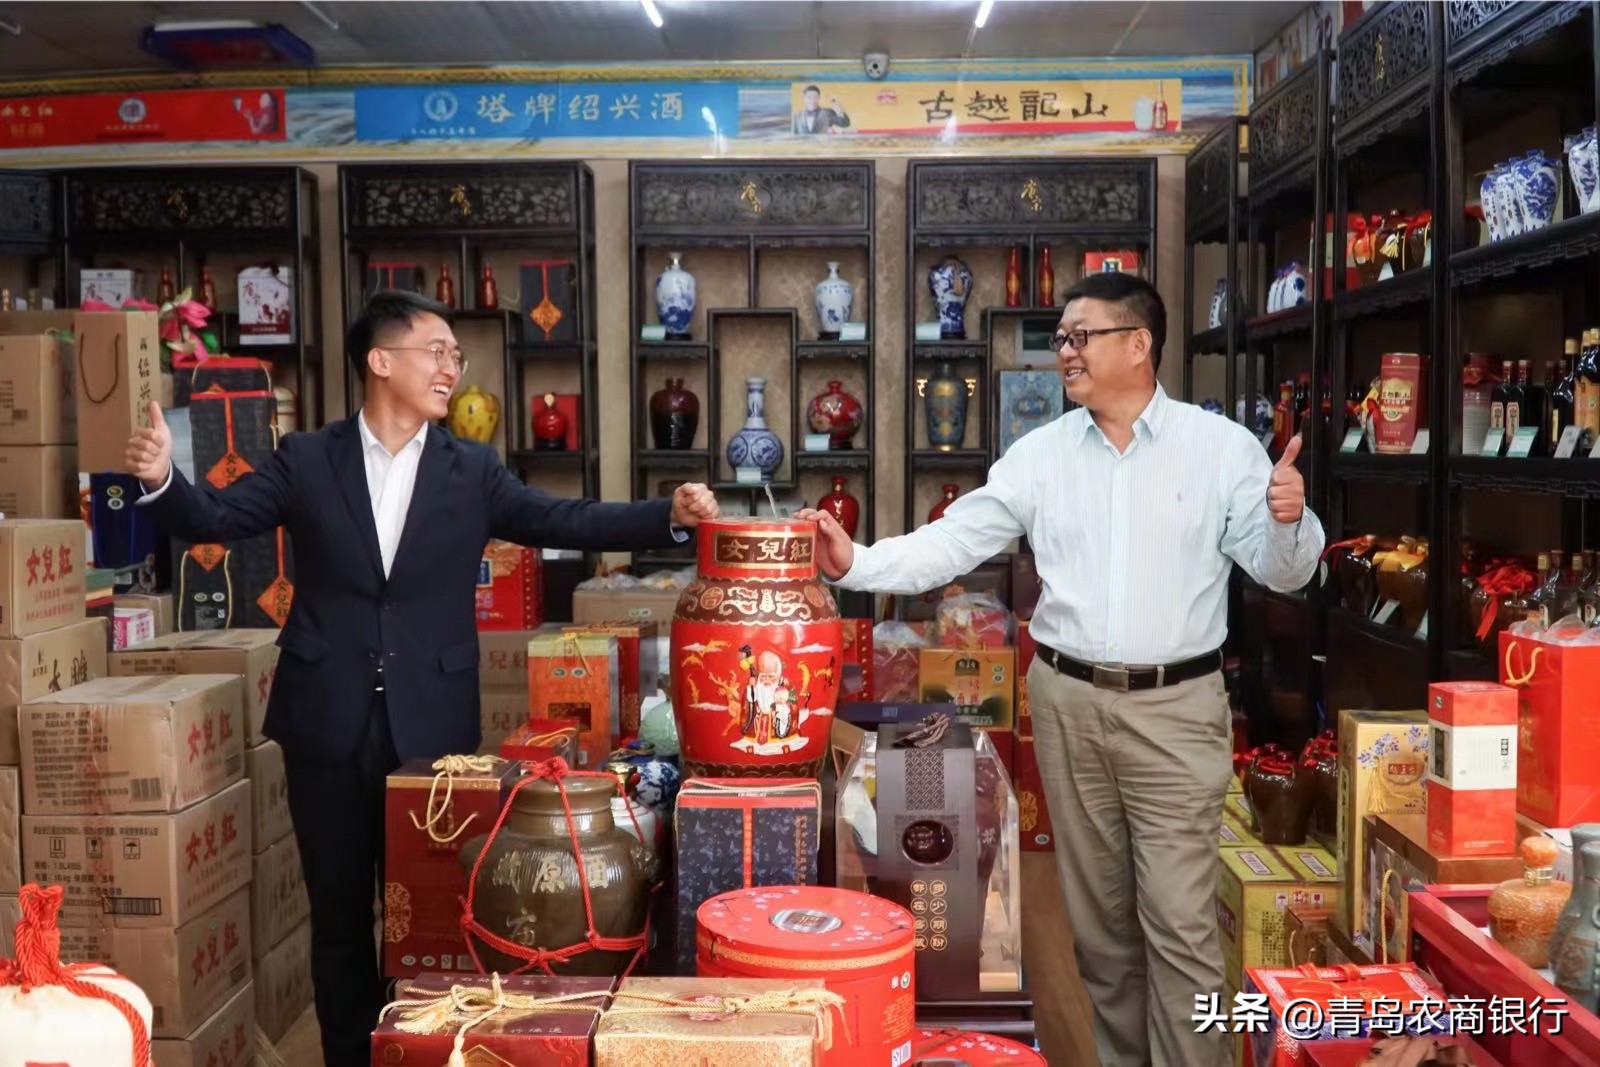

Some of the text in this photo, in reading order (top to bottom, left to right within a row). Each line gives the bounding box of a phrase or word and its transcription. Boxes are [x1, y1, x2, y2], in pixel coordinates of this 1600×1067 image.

[476, 91, 685, 124] 塔牌绍兴酒
[919, 89, 1110, 122] 古越龍山
[722, 538, 811, 562] 女兒紅
